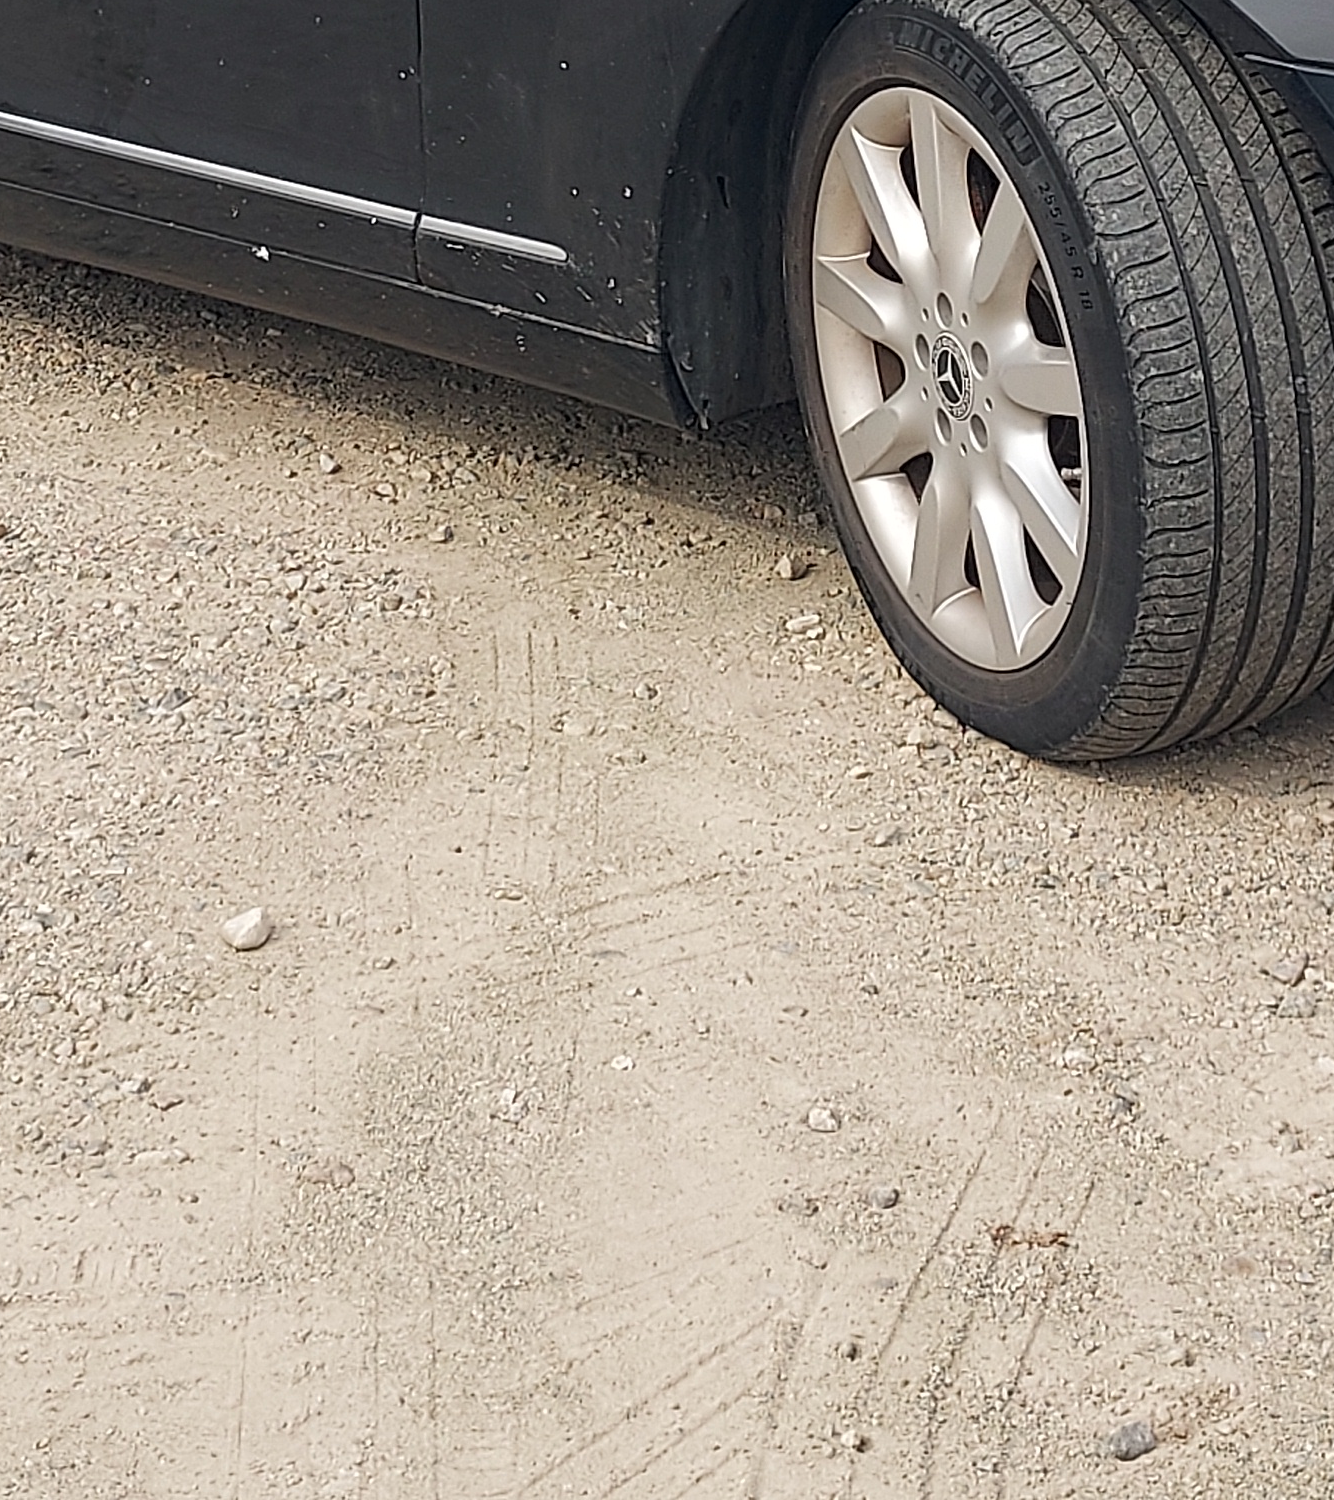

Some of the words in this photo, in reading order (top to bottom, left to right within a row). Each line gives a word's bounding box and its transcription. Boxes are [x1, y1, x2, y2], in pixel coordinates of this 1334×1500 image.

[897, 19, 1034, 152] MICHELIN
[1038, 181, 1078, 258] 255/45
[1070, 265, 1084, 280] R
